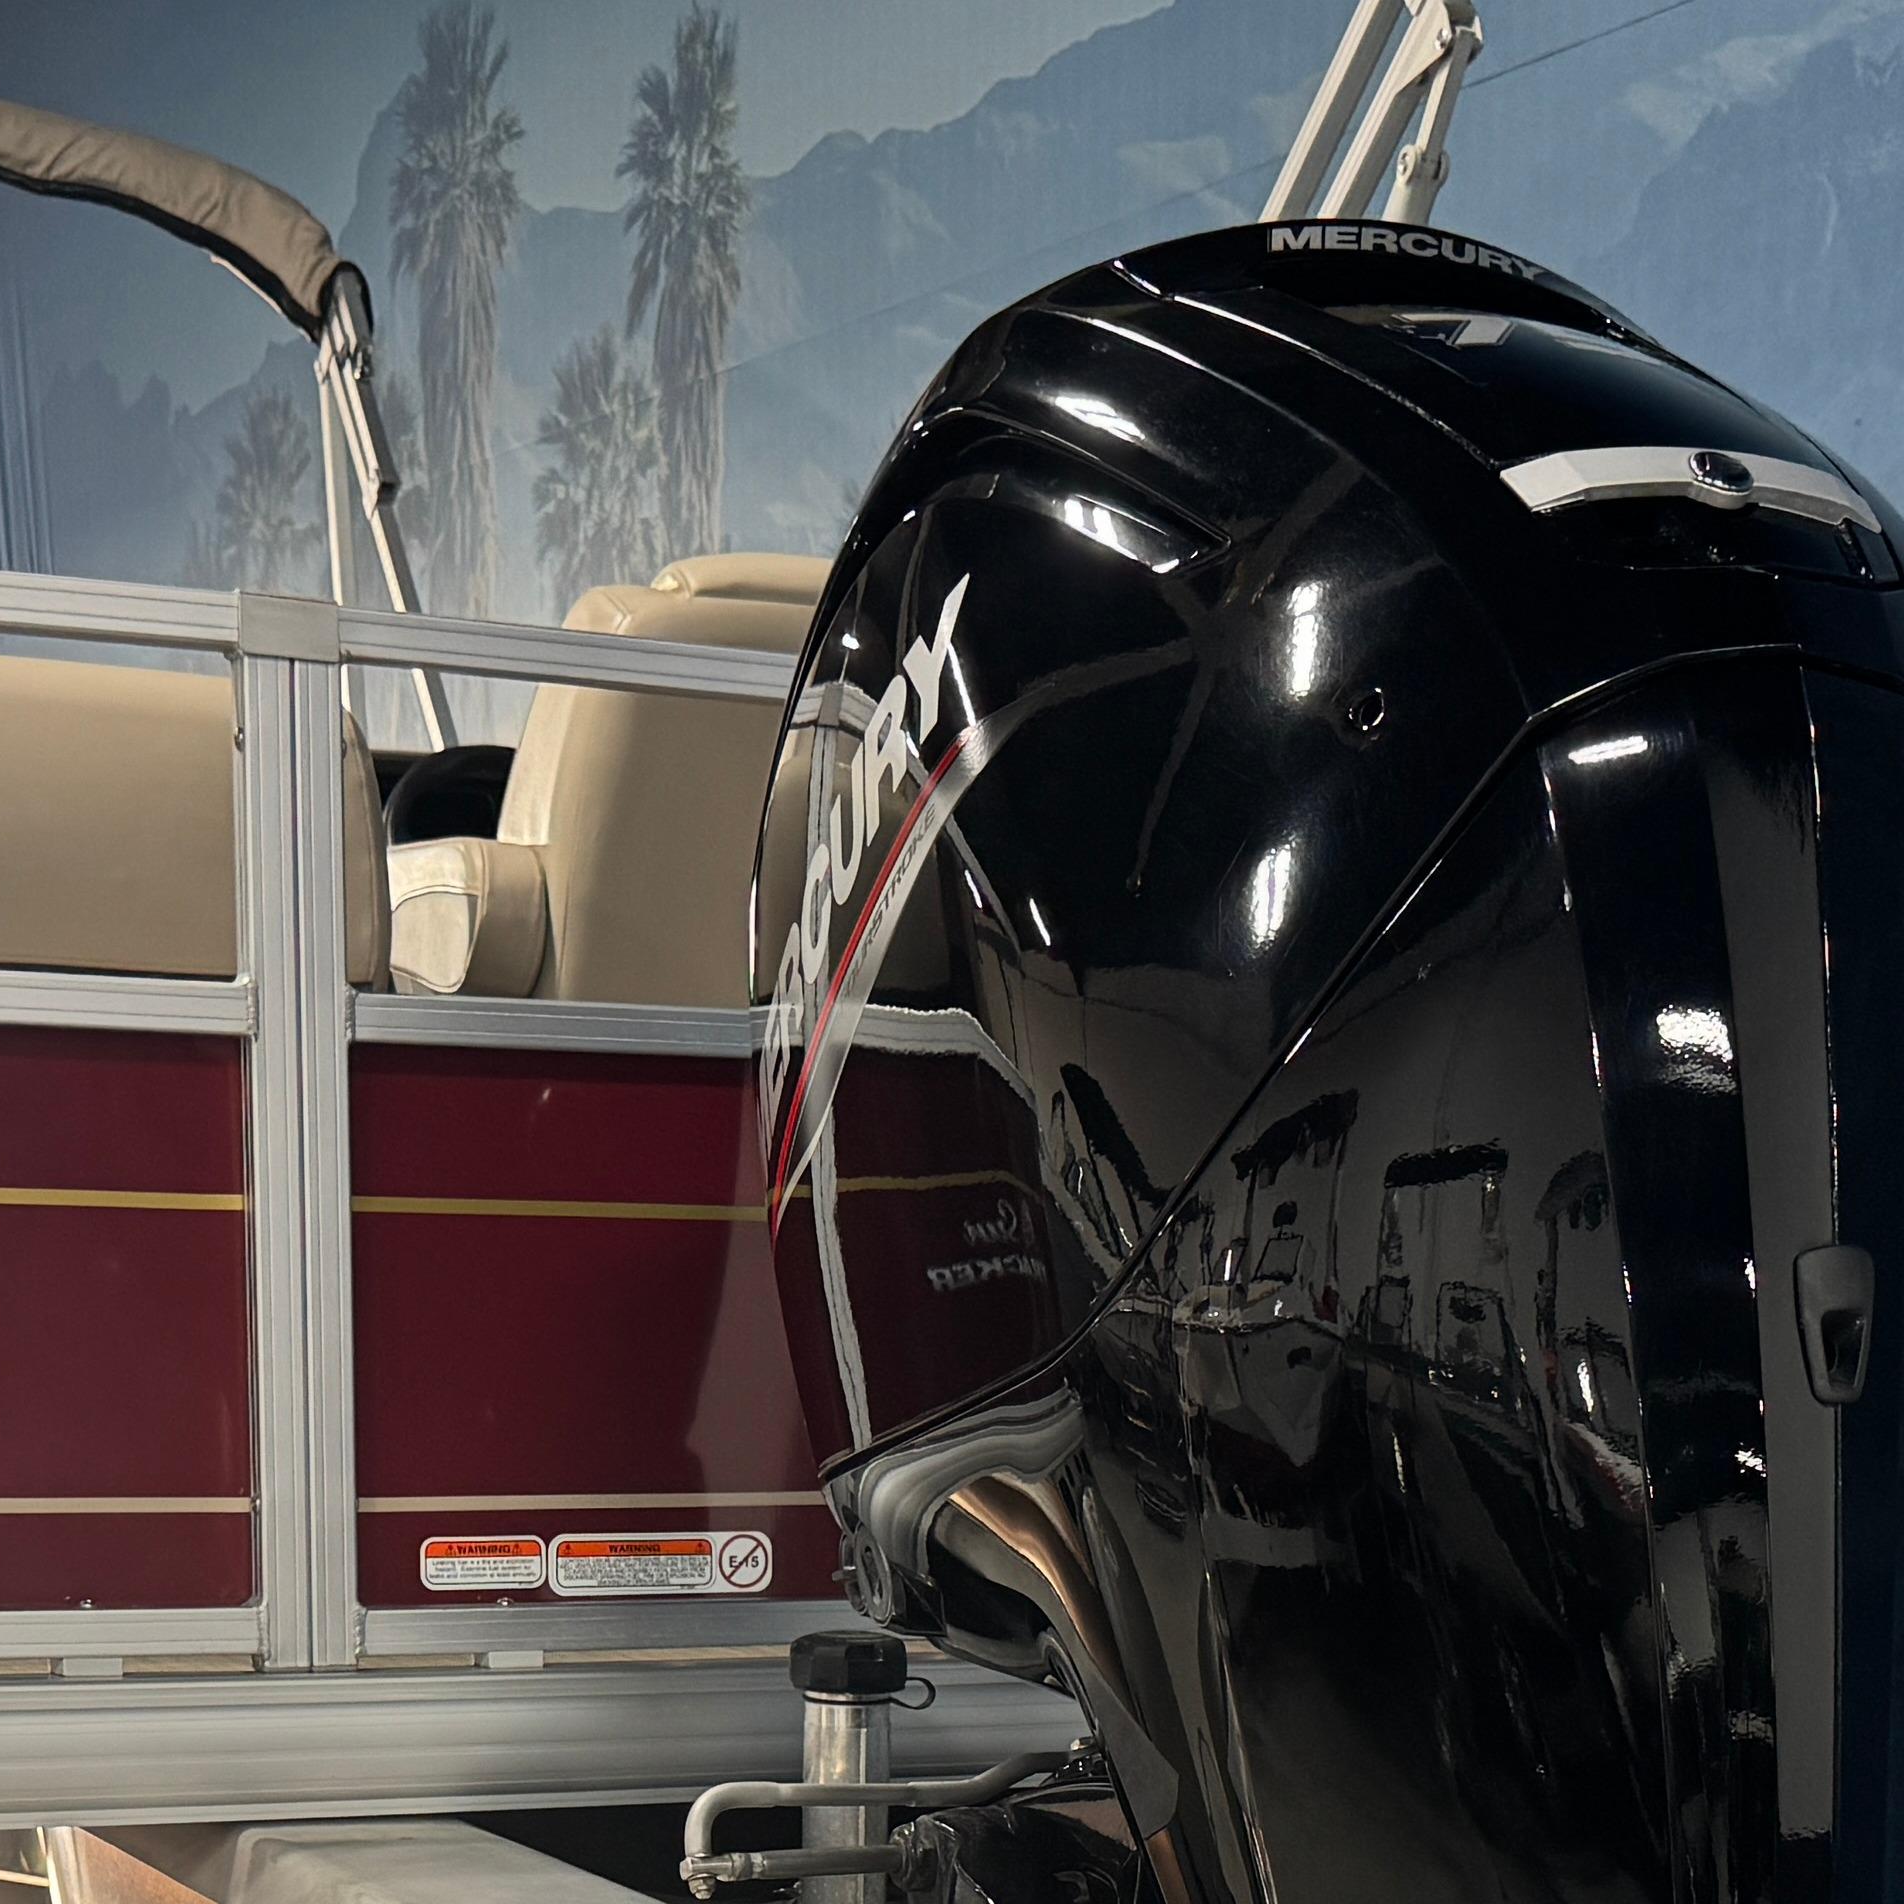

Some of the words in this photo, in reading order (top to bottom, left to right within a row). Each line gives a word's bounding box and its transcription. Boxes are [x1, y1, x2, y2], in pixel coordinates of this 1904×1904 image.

[1270, 225, 1549, 281] MERCURY
[757, 573, 970, 1180] ERCURY
[456, 1544, 511, 1554] WARNING
[608, 1544, 661, 1554] WARNING
[728, 1555, 760, 1568] E-15
